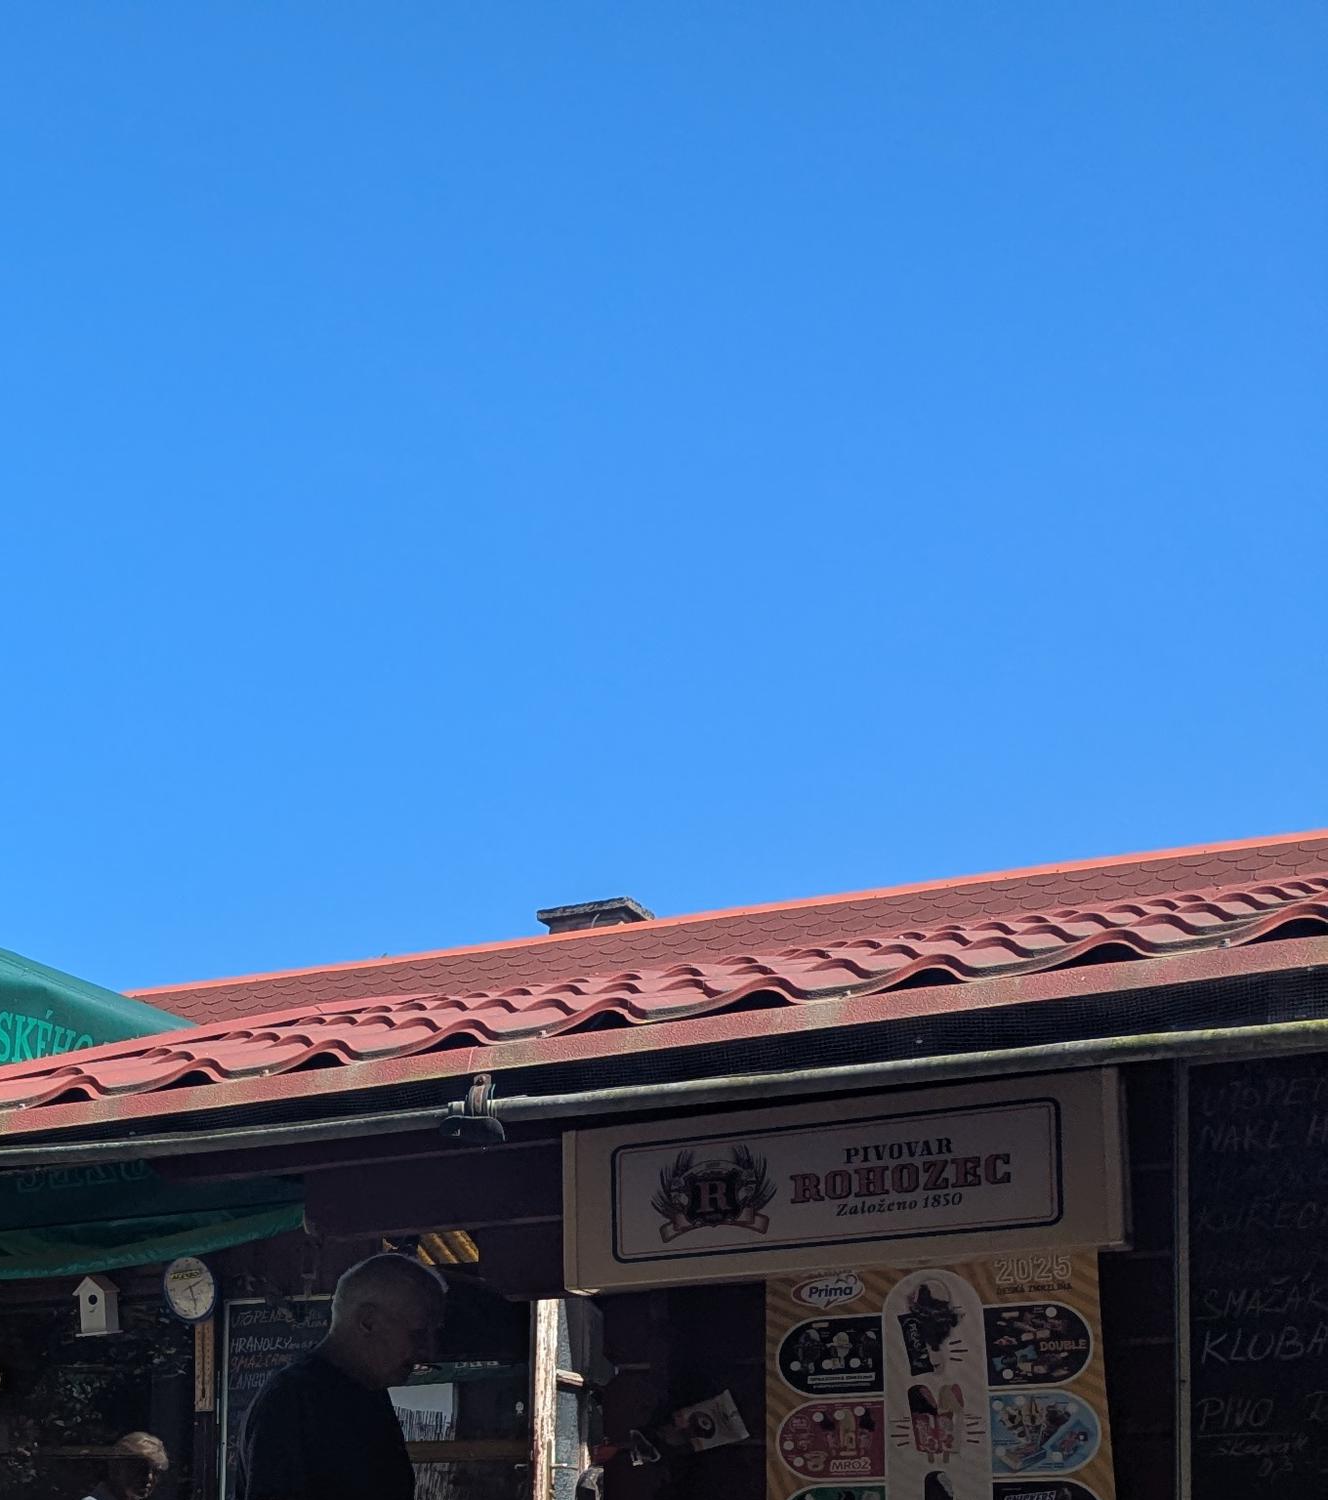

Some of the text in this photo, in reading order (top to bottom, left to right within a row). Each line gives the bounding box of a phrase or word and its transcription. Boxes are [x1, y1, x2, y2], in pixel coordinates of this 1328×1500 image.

[844, 1138, 952, 1163] PIVOVAR
[790, 1153, 1011, 1204] ROHOZEC
[836, 1193, 962, 1216] Založeno 1850
[994, 1255, 1072, 1284] 2025
[808, 1284, 853, 1298] Prima
[1040, 1339, 1088, 1351] DOUBLE
